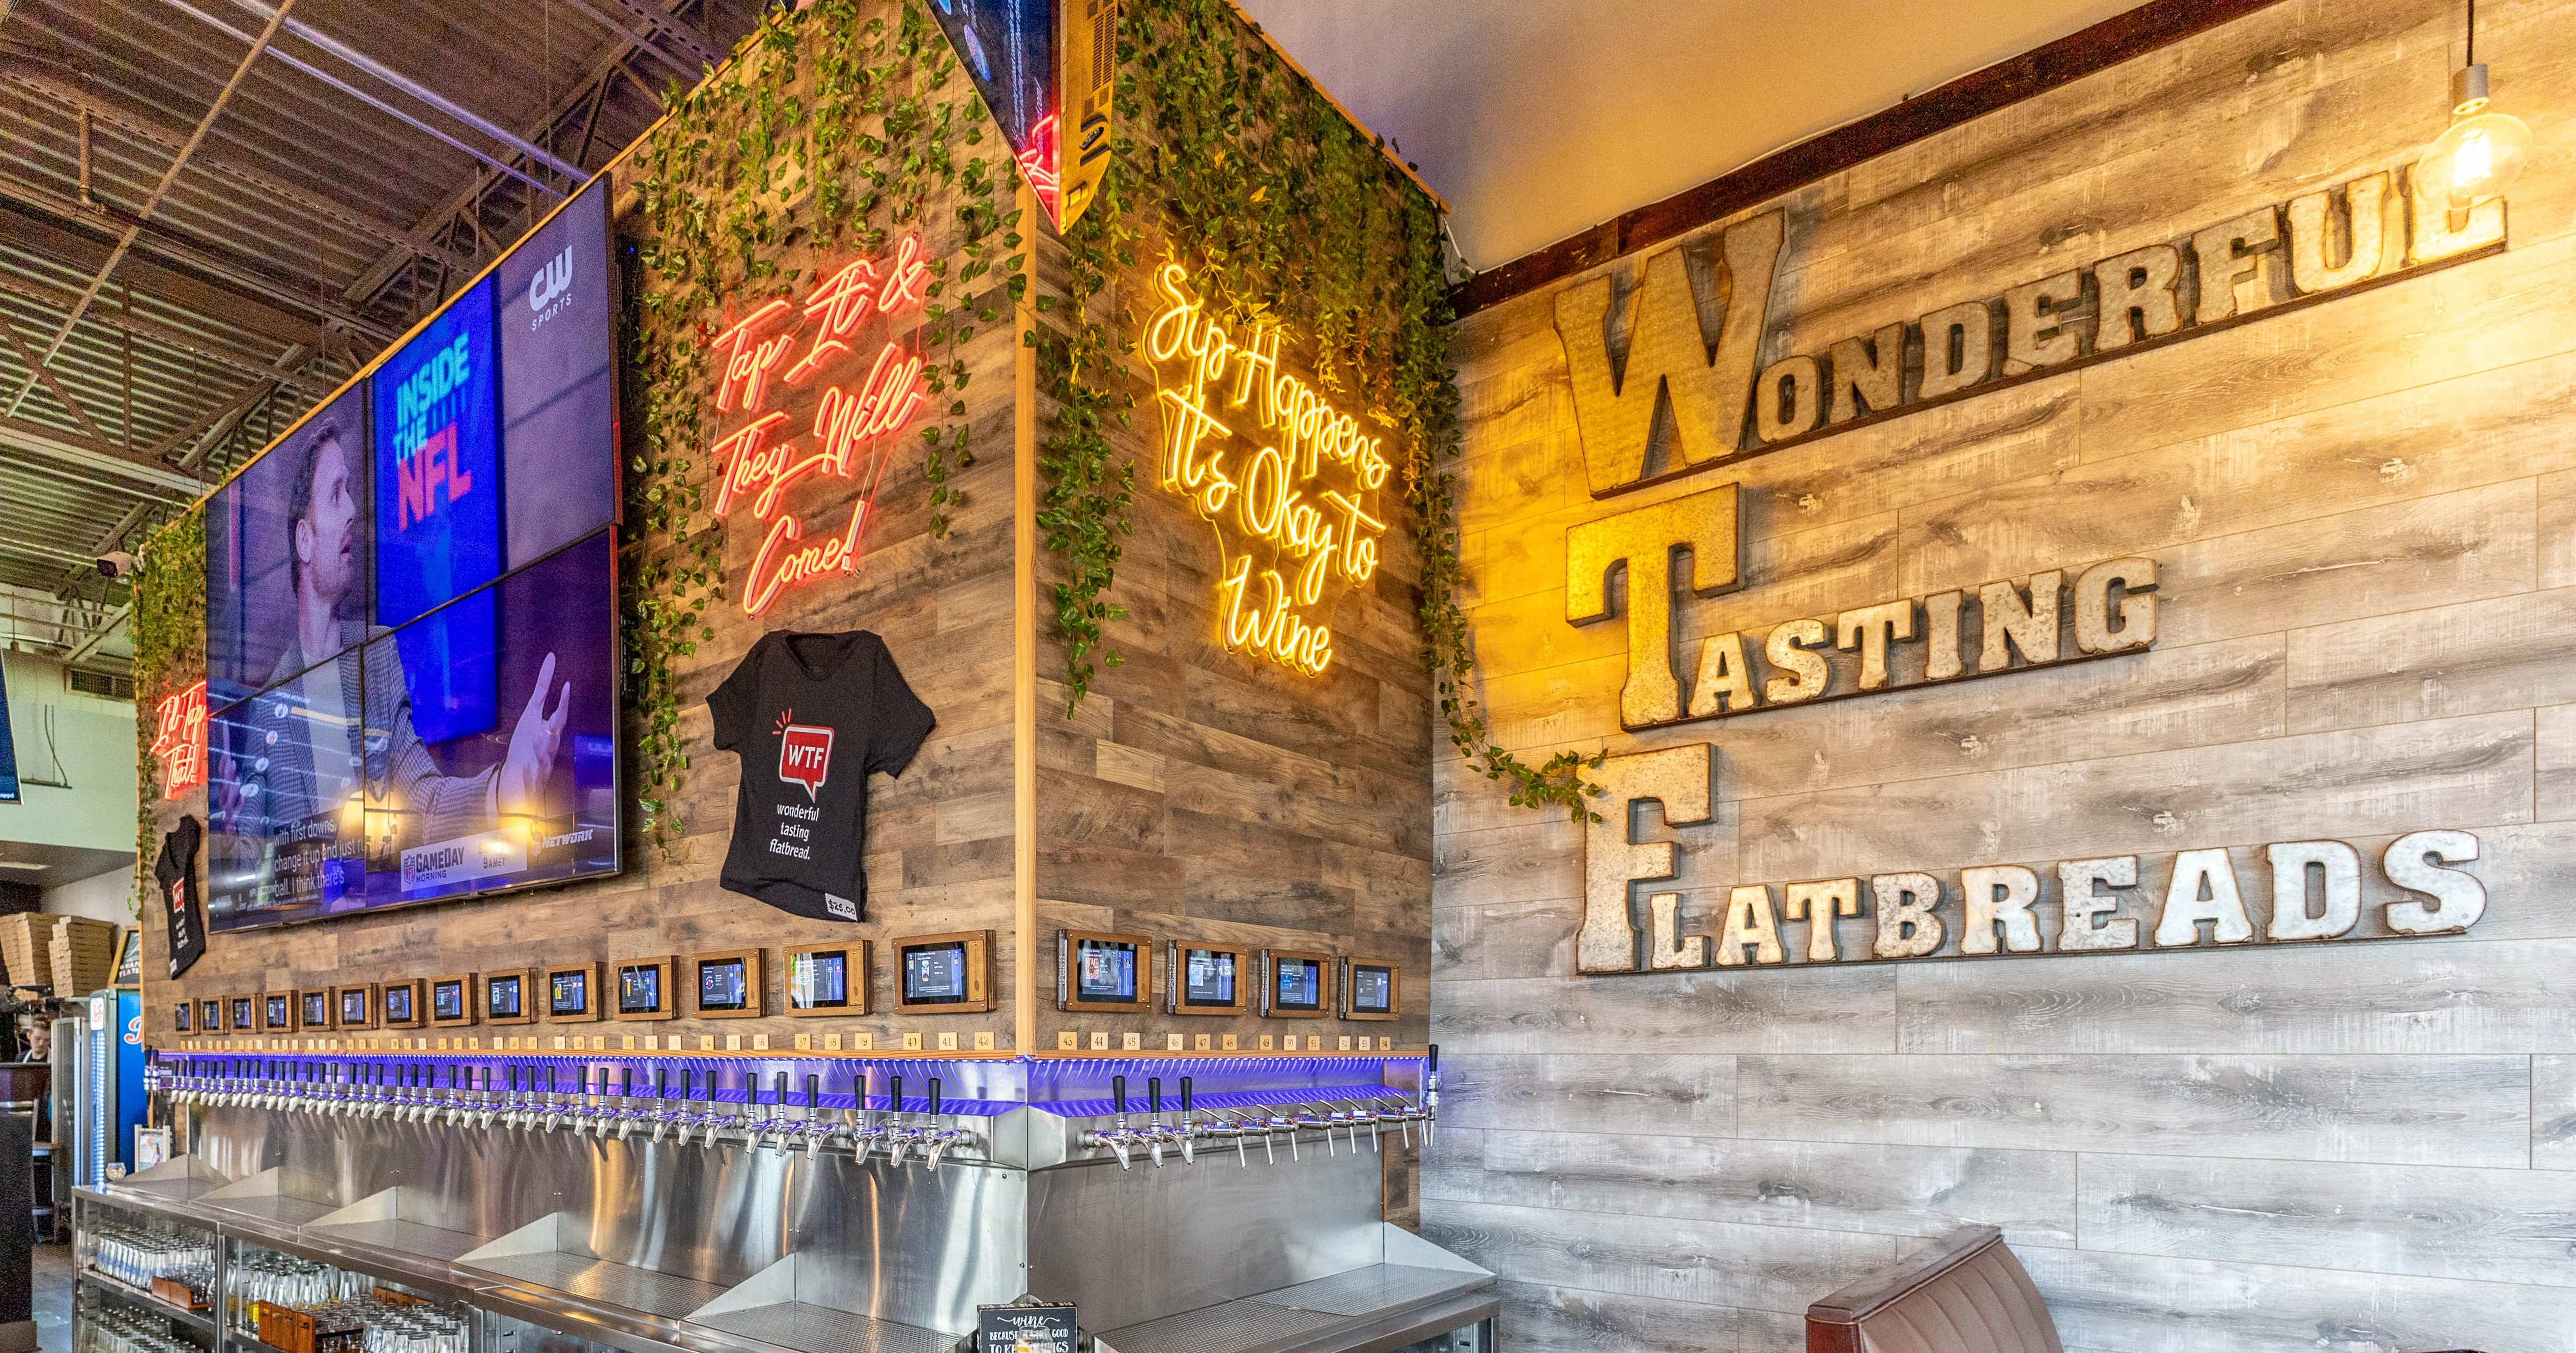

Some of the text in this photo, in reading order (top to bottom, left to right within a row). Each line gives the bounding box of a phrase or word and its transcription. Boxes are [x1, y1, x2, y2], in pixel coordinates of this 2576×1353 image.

[529, 245, 572, 312] CW
[532, 292, 572, 332] SPORTS
[712, 299, 794, 411] Tap
[878, 234, 925, 312] &
[1553, 153, 2506, 496] WONDERFUL
[396, 331, 469, 429] INSIDE
[1152, 264, 1391, 488] Sip Happens
[392, 411, 428, 466] THE
[711, 342, 923, 519] They Will
[398, 421, 472, 531] NFL
[1248, 446, 1338, 605] Okay
[743, 499, 866, 614] Come!
[1224, 554, 1332, 672] Wine
[1566, 481, 2158, 729] TASTING
[181, 680, 207, 745] Tap
[788, 744, 824, 769] WTF
[777, 803, 820, 822] wonderful
[274, 826, 290, 847] with
[291, 825, 306, 842] first
[780, 821, 810, 842] tasting
[274, 854, 302, 872] change
[303, 850, 309, 866] it
[310, 850, 321, 867] up
[322, 840, 337, 861] and
[339, 839, 356, 863] just
[769, 838, 811, 861] flatbread.
[1576, 742, 2487, 972] FLATBREADS
[275, 878, 291, 897] ball.
[296, 872, 316, 893] think
[317, 869, 345, 888] there's
[416, 869, 447, 883] MORNING
[828, 898, 856, 916] $25.00
[907, 1037, 917, 1047] 40
[942, 1036, 952, 1046] 41
[1063, 1036, 1073, 1046] 43
[1095, 1036, 1103, 1046] 44
[1127, 1037, 1136, 1046] 45
[1171, 1037, 1179, 1047] 46
[1199, 1038, 1207, 1047] 47
[1226, 1038, 1234, 1047] 48
[997, 1315, 1060, 1328] wine
[989, 1330, 1019, 1341] BECAUSE
[1051, 1328, 1068, 1338] GOOD
[989, 1344, 1002, 1353] TO
